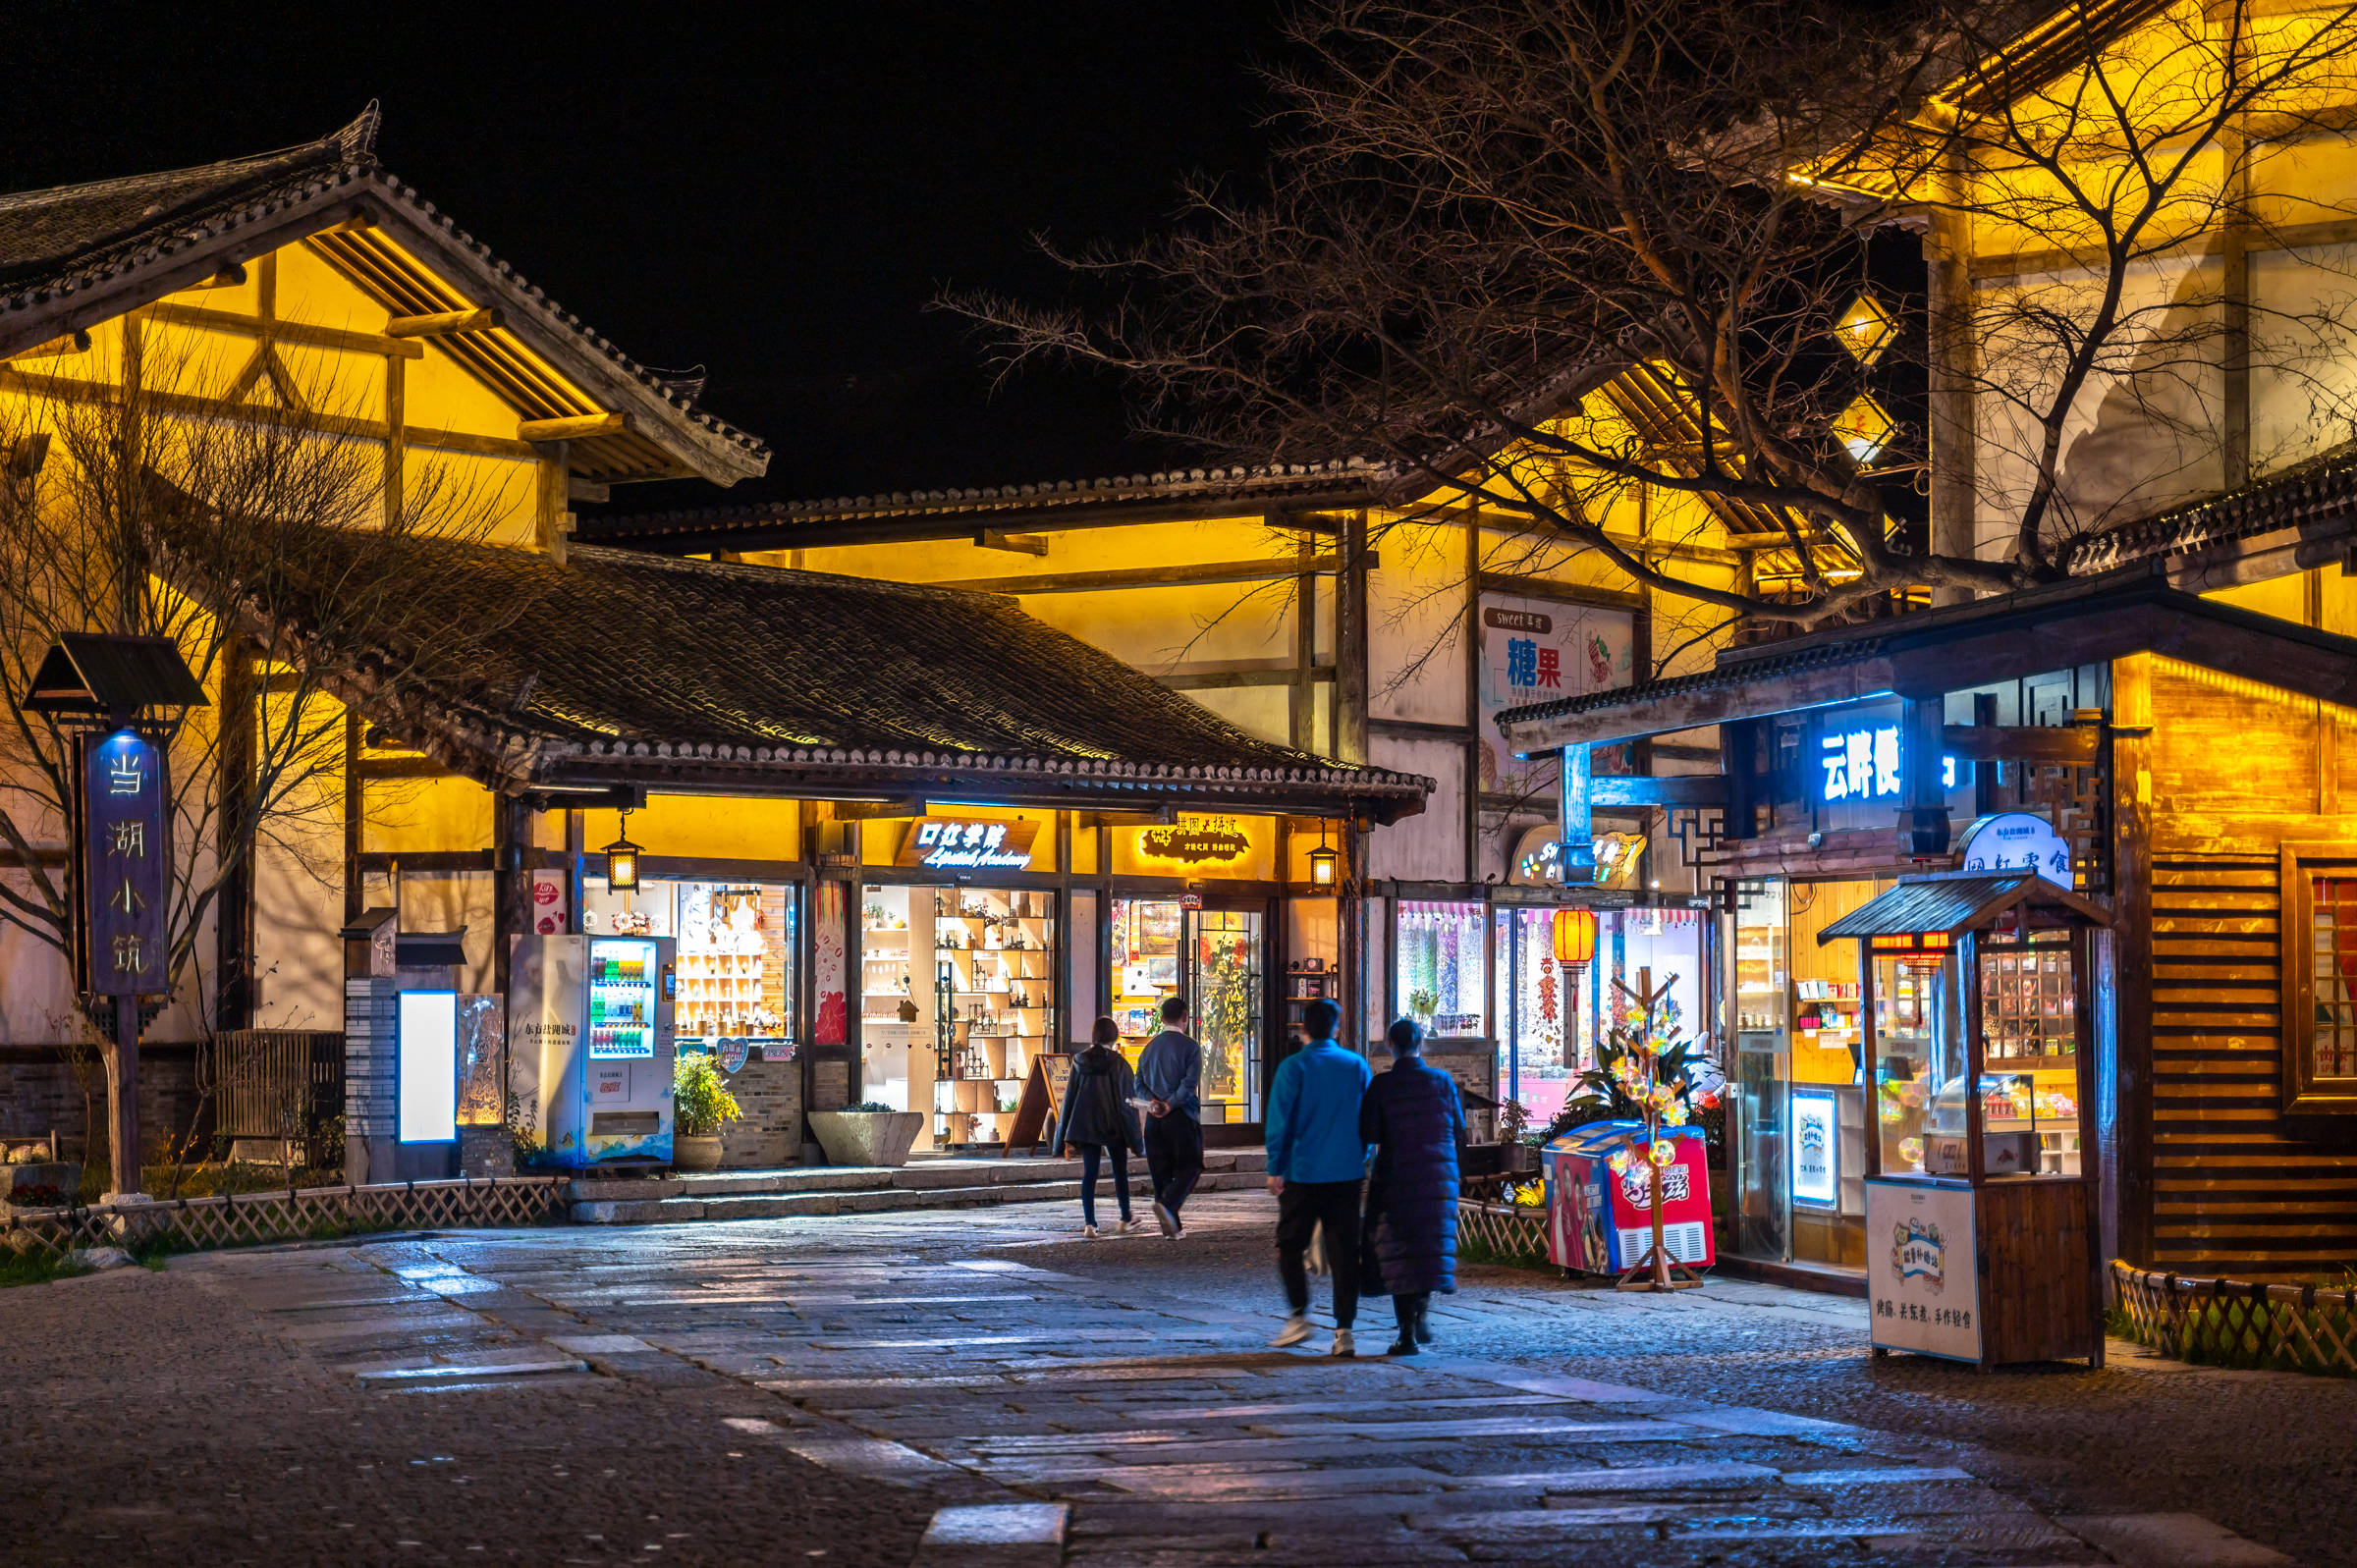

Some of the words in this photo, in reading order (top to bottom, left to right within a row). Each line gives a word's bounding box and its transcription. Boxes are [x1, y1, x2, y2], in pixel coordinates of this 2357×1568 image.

[1507, 636, 1562, 688] 糖果
[918, 822, 1007, 849] 口红学院
